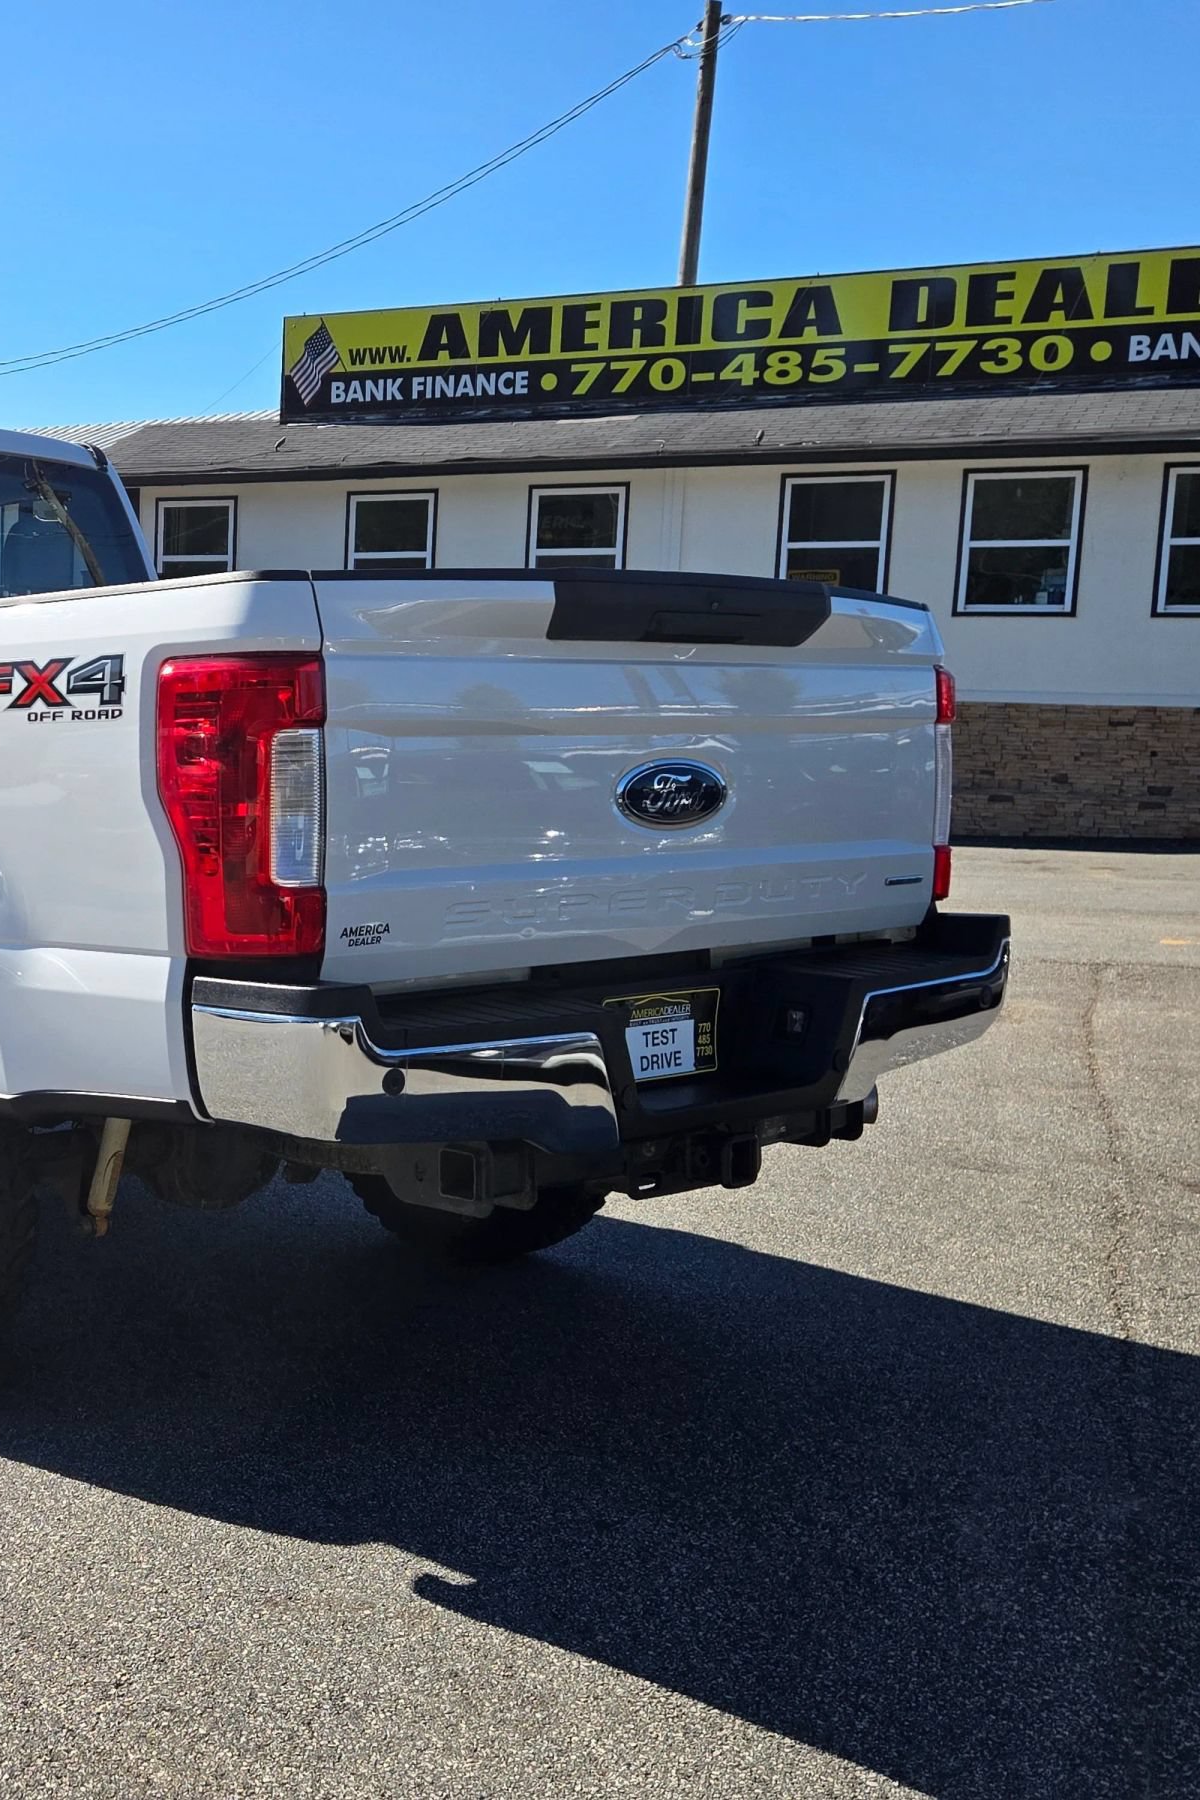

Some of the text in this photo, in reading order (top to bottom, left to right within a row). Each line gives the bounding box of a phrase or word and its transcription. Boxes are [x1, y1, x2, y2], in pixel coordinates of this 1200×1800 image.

[416, 284, 843, 362] AMERICA
[570, 334, 1074, 396] 770-485-7730
[330, 370, 529, 404] BANK FINANCE
[27, 709, 124, 722] OFF ROAD
[641, 773, 706, 815] Ford
[443, 871, 868, 926] SUPER DUTY
[339, 922, 391, 939] AMERICA
[347, 935, 383, 947] DEALER
[697, 1022, 711, 1033] 770
[642, 1028, 678, 1048] TEST
[697, 1034, 711, 1045] 485
[640, 1050, 682, 1072] DRIVE
[696, 1045, 713, 1057] 7730
